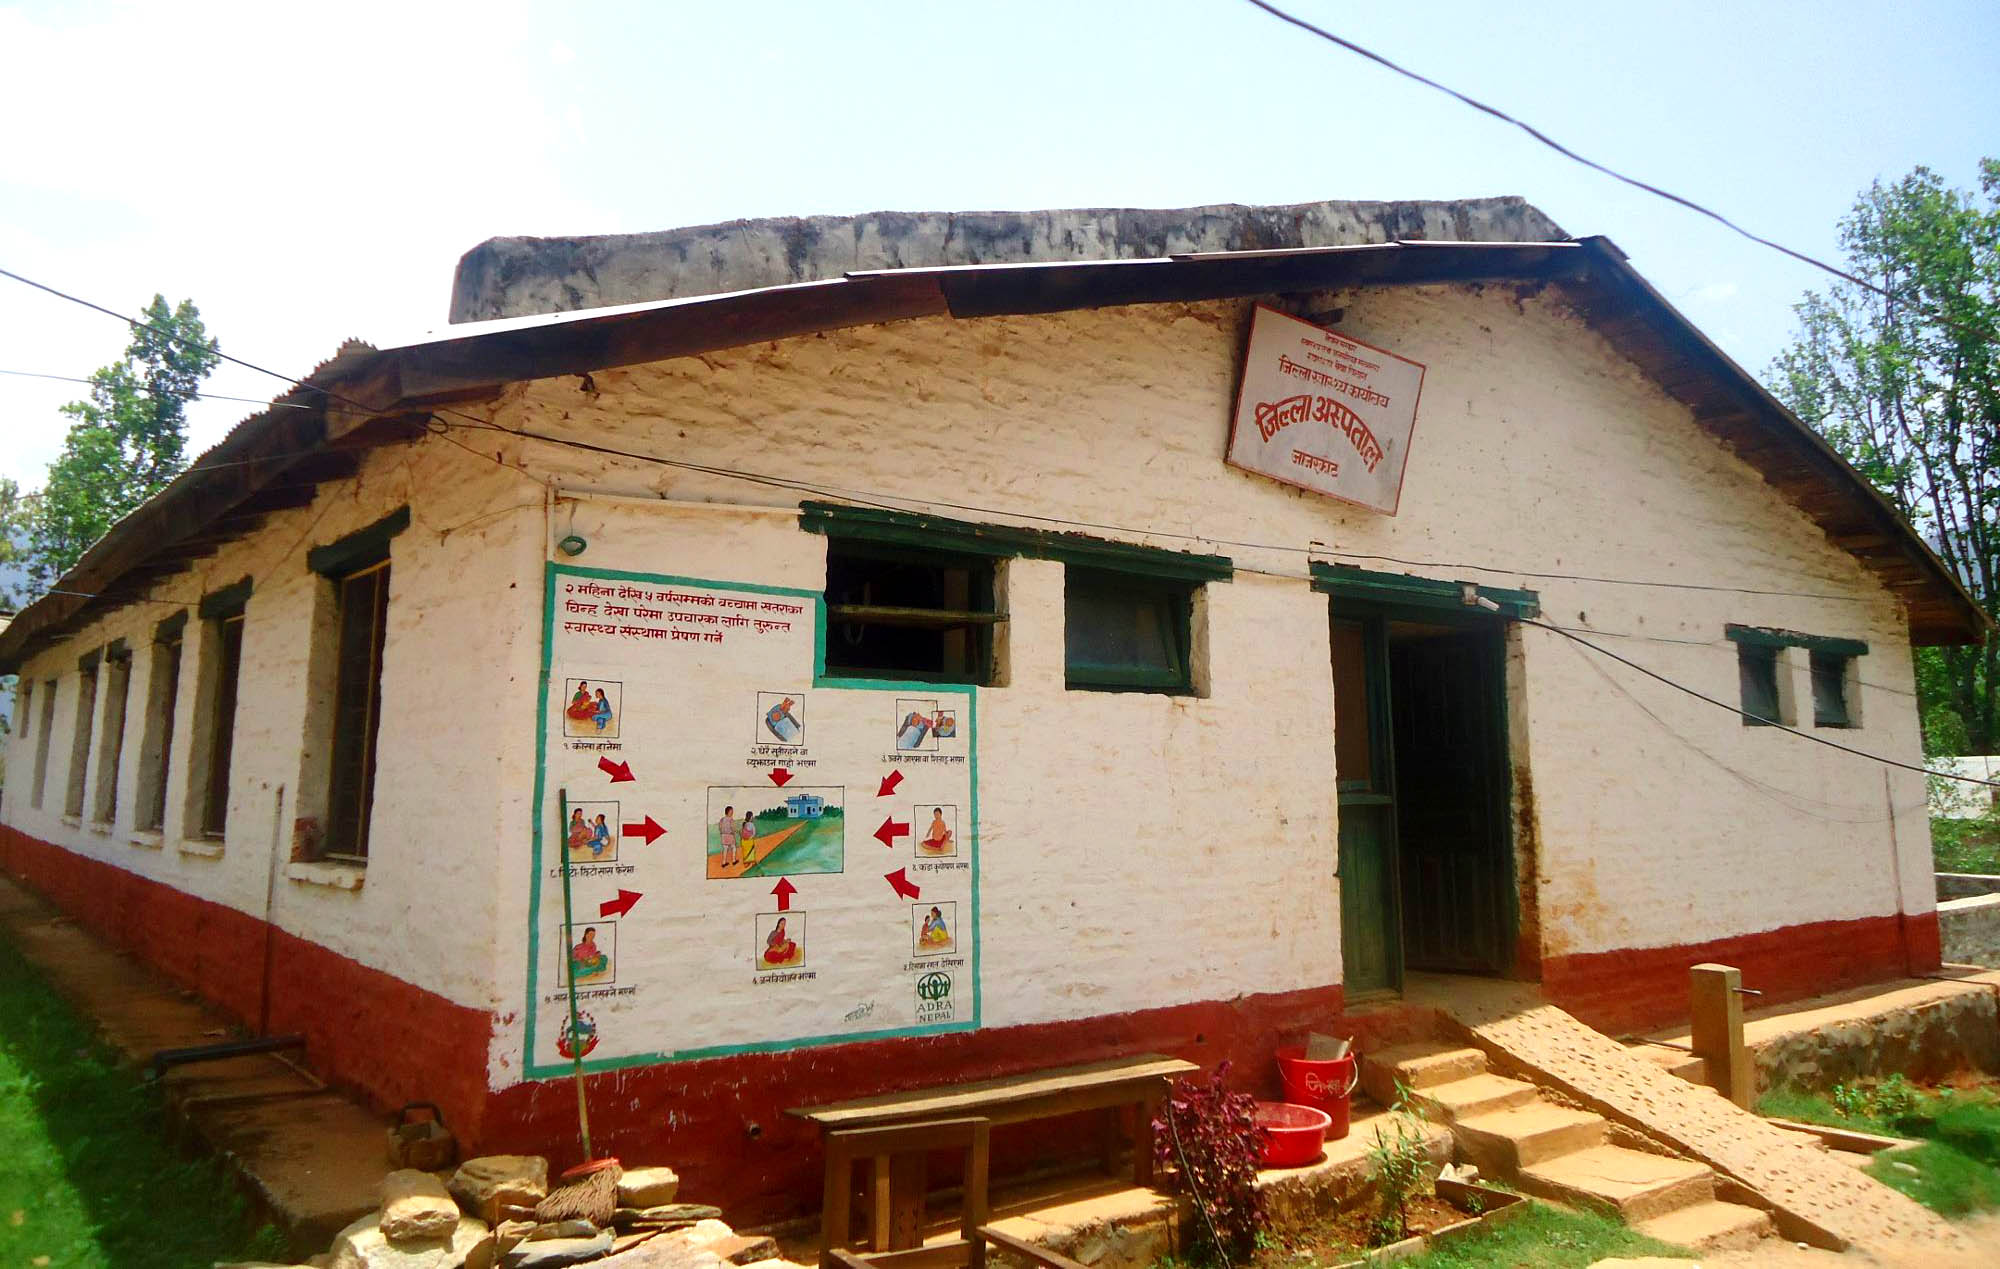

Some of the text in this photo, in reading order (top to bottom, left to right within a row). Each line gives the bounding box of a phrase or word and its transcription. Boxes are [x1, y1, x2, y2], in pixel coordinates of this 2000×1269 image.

[1279, 354, 1312, 381] जिल्ला
[1348, 384, 1390, 408] कार्यालय
[1255, 395, 1384, 473] जिल्ला अस्पताल
[565, 583, 574, 593] २
[577, 582, 615, 598] महिना
[618, 585, 643, 603] देखि
[718, 597, 757, 610] बच्चामा
[761, 601, 803, 616] खतराका
[565, 600, 599, 617] चिन्ह
[604, 602, 630, 621] देखा
[633, 605, 663, 622] परेमा
[668, 611, 719, 627] उपचारका
[721, 613, 749, 628] लागि
[564, 621, 617, 636] स्वास्थ्य
[620, 625, 668, 640] संस्थामा
[671, 626, 700, 643] प्रेषण
[917, 1000, 952, 1013] ADRA
[918, 1012, 951, 1023] NEPAL
